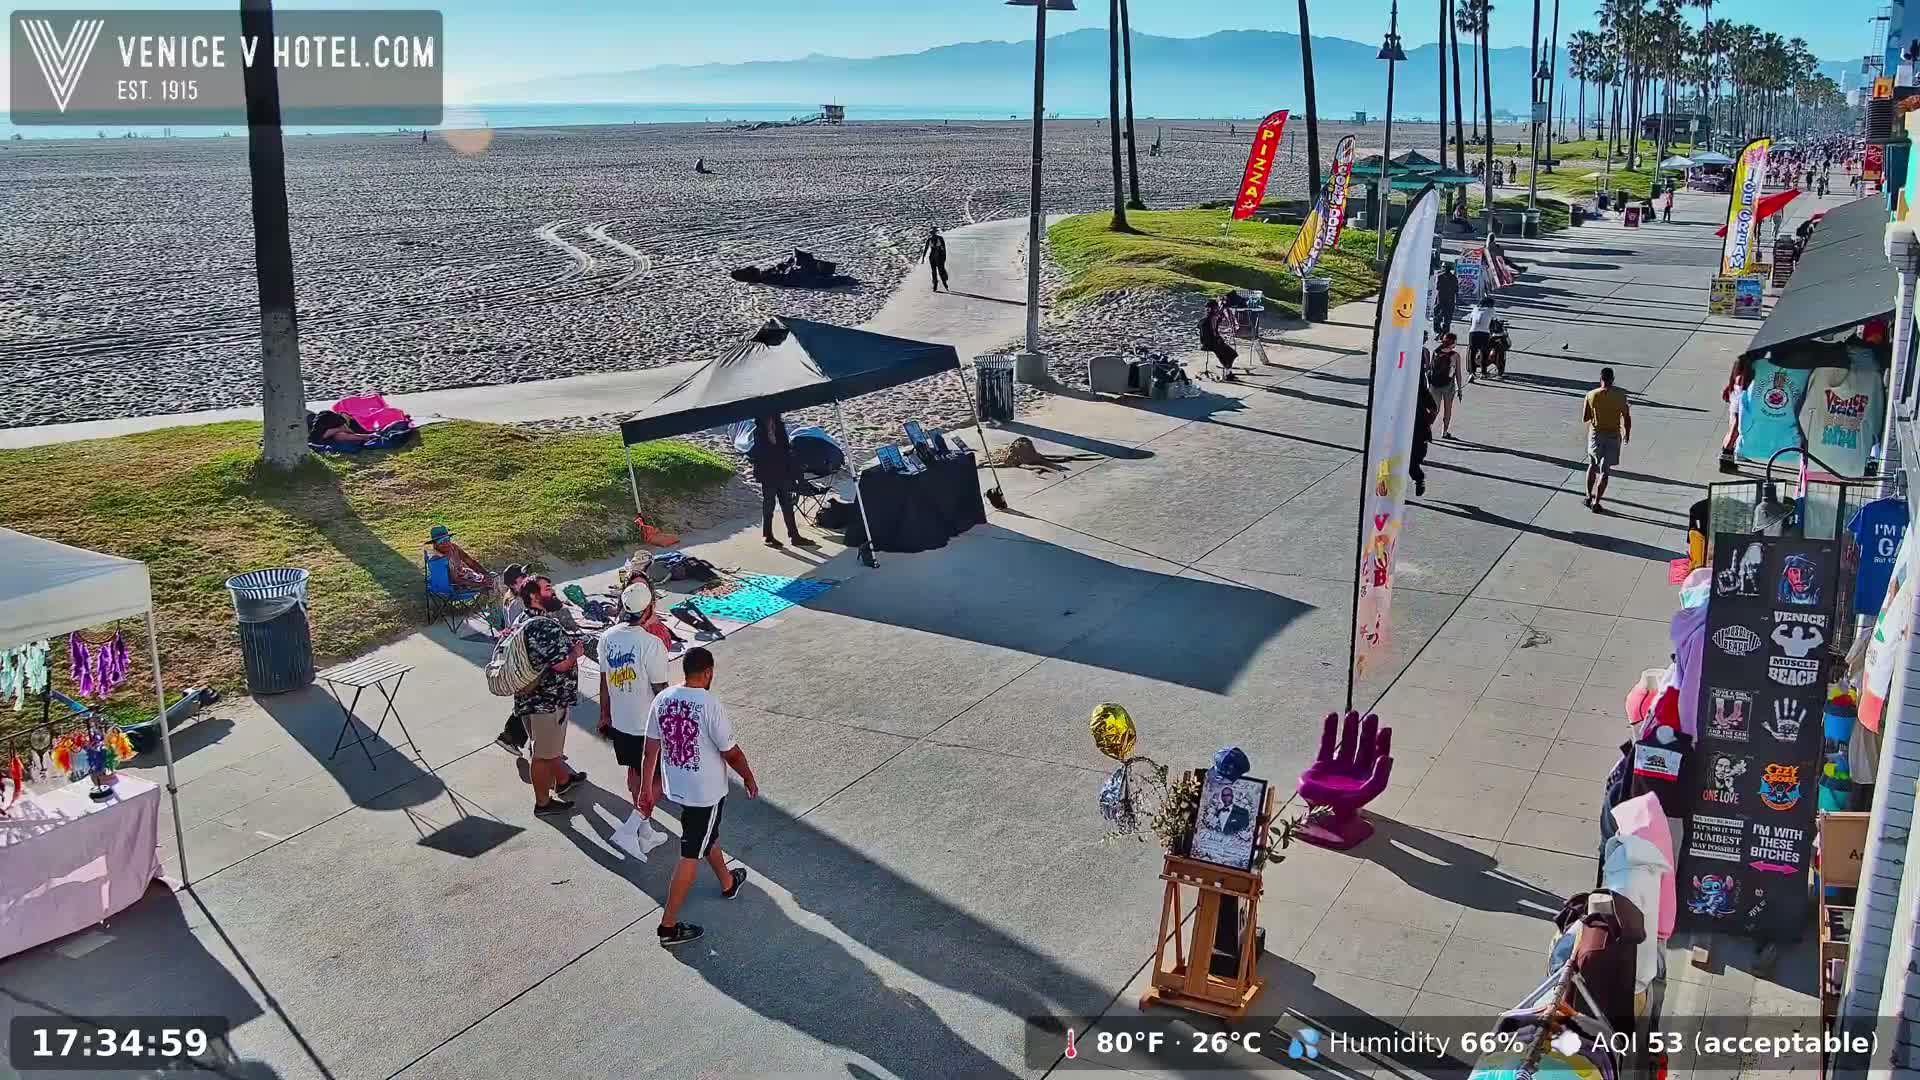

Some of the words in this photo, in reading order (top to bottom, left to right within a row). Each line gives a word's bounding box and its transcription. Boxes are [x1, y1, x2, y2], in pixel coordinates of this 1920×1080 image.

[1245, 129, 1274, 198] PIZZA
[1742, 168, 1756, 206] ICE
[1729, 209, 1752, 270] CREAM
[1874, 523, 1896, 536] I'M
[1773, 610, 1826, 627] VENICE
[1723, 639, 1749, 652] BEACH
[1773, 658, 1816, 668] MUSCLE
[1767, 666, 1819, 687] BEACH
[1702, 788, 1719, 802] ONE
[1720, 790, 1741, 804] LOVE
[1692, 831, 1742, 846] DUMBEST
[1752, 823, 1770, 836] I'M
[1774, 827, 1804, 841] WITH
[1691, 841, 1707, 850] WAY
[1707, 843, 1742, 854] POSSIBLE
[1759, 836, 1795, 851] THESE
[1750, 846, 1801, 863] BITCHES
